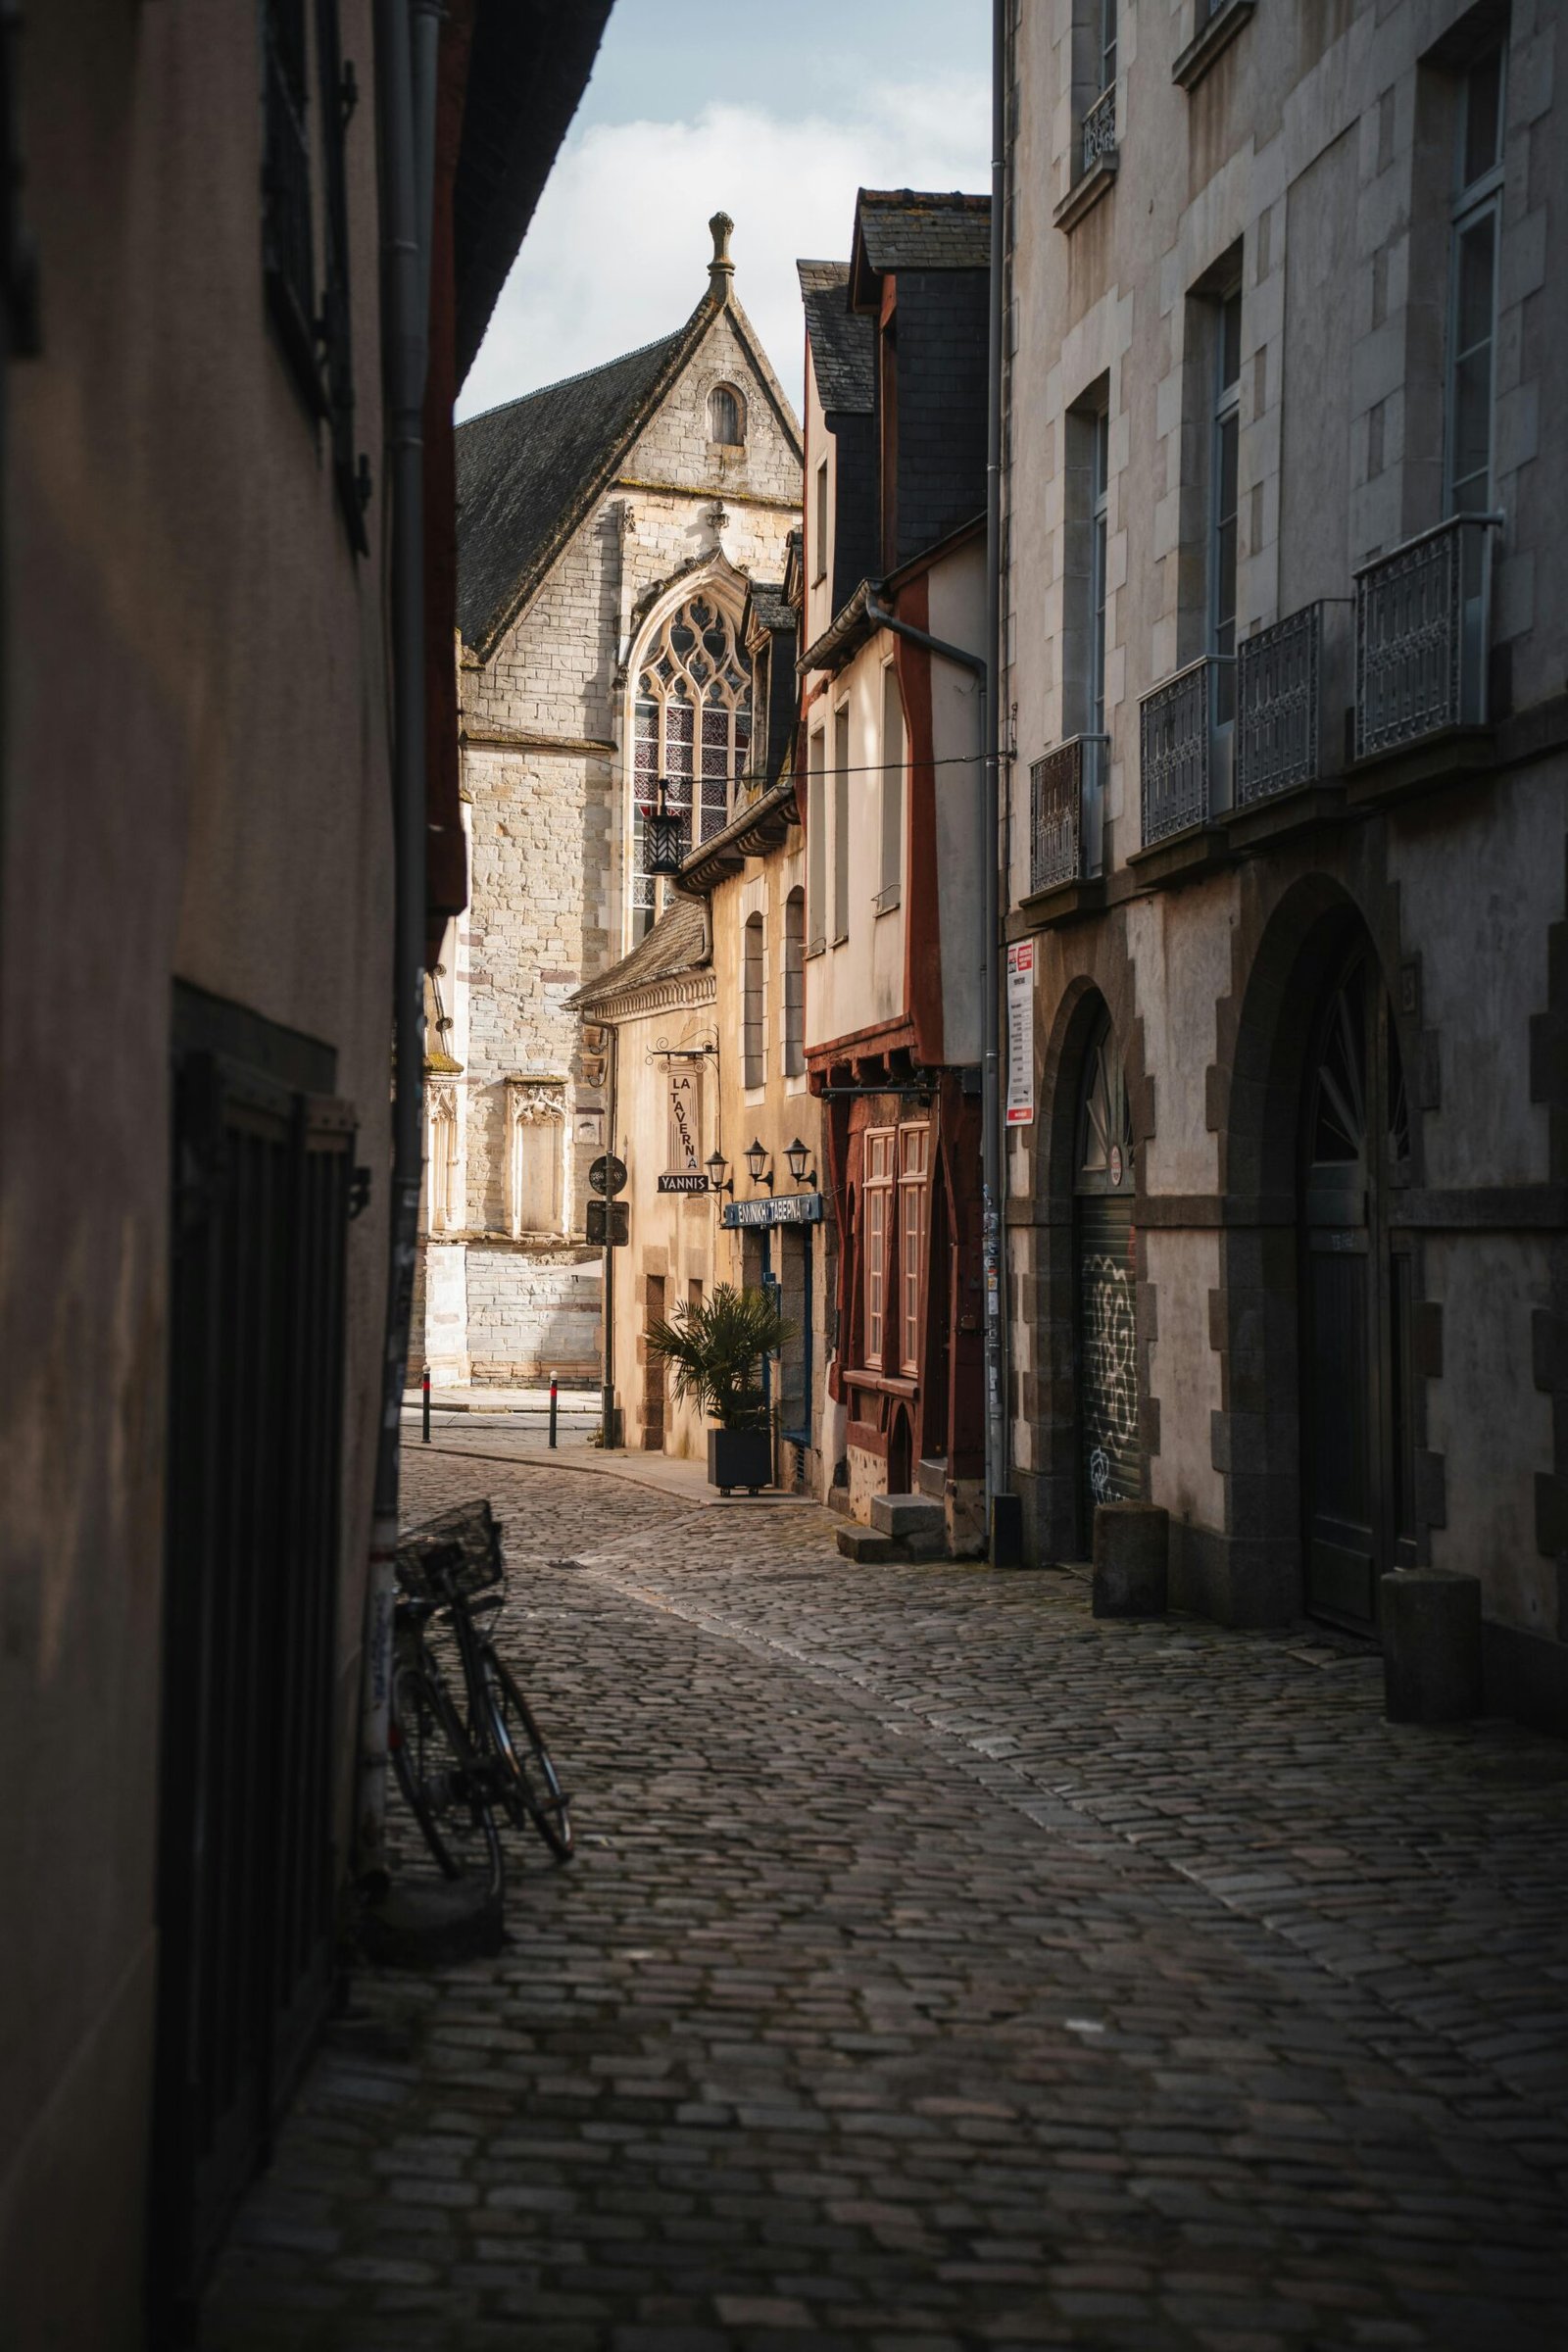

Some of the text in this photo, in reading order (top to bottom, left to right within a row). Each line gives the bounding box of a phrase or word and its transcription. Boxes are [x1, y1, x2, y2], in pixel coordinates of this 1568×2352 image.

[670, 1078, 697, 1168] LA TAVERNA
[662, 1177, 706, 1189] YANNIS
